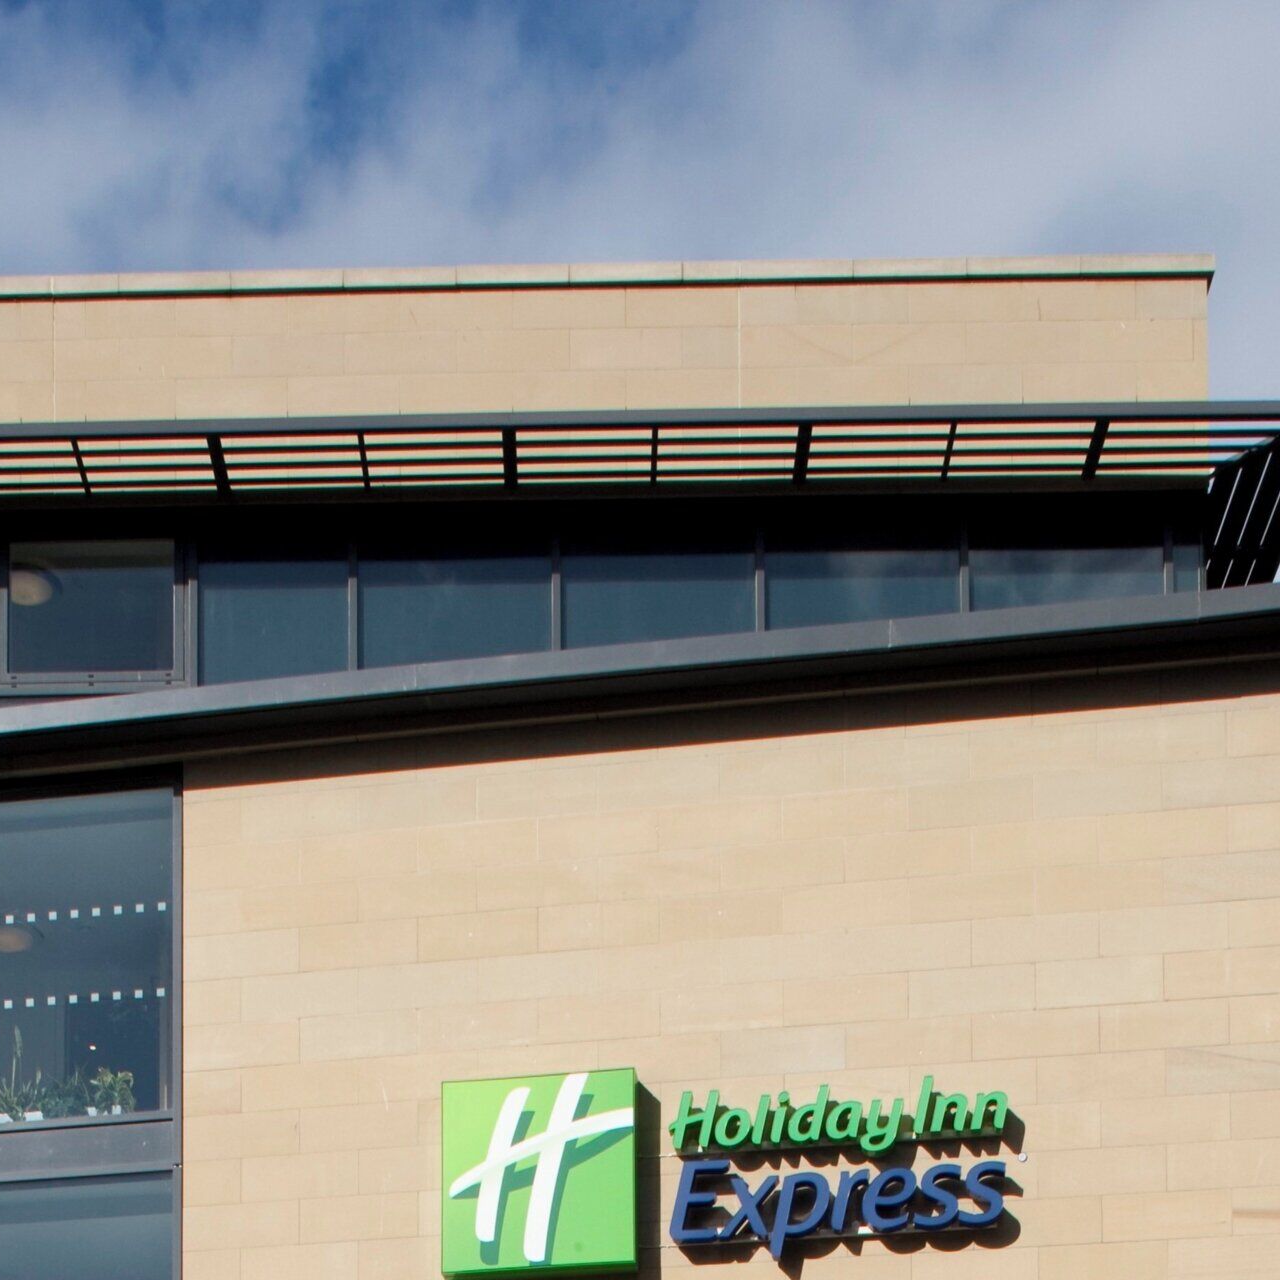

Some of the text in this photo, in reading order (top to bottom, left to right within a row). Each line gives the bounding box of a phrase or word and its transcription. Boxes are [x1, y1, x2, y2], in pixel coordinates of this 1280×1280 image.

[668, 1075, 1010, 1154] Holiday Inn
[669, 1159, 1007, 1261] Express
